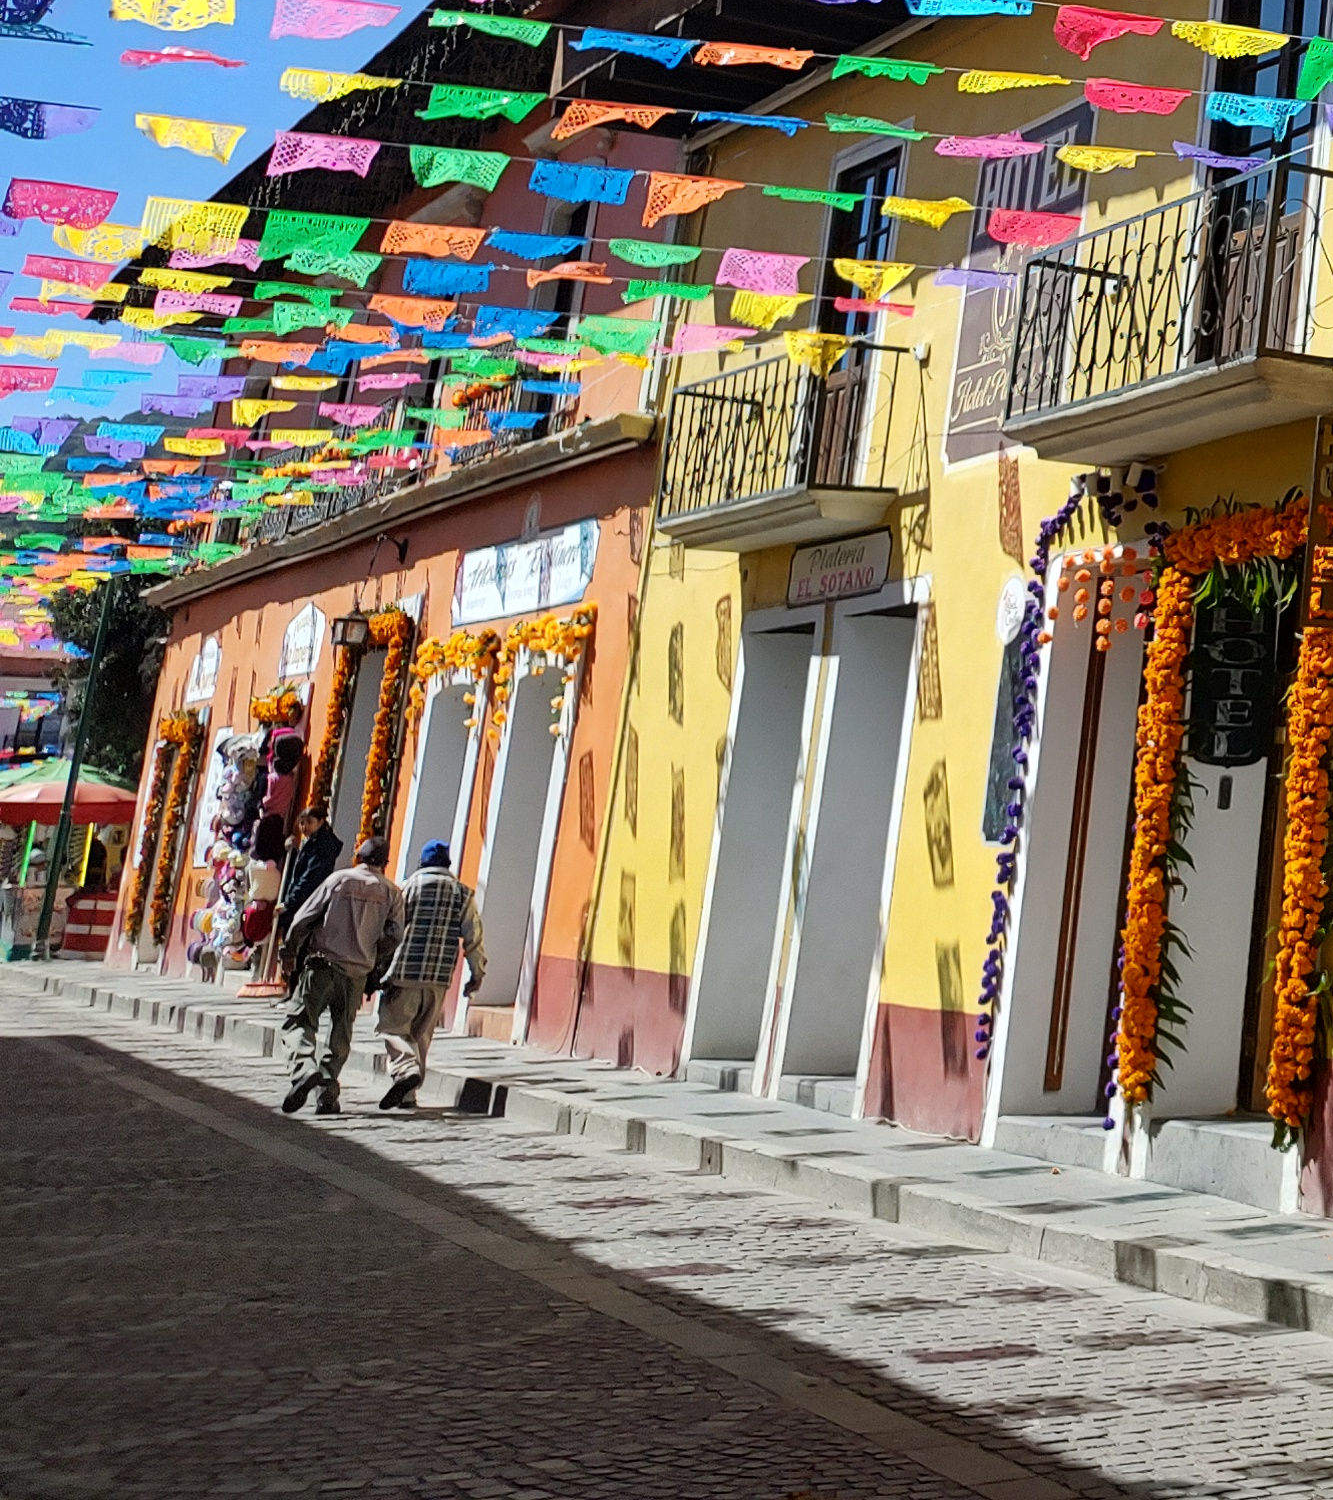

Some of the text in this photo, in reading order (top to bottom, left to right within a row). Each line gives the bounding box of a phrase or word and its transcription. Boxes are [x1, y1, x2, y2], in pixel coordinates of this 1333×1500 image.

[976, 122, 1082, 237] HOTEL
[797, 577, 812, 598] EL
[1205, 606, 1267, 759] HOTEL
